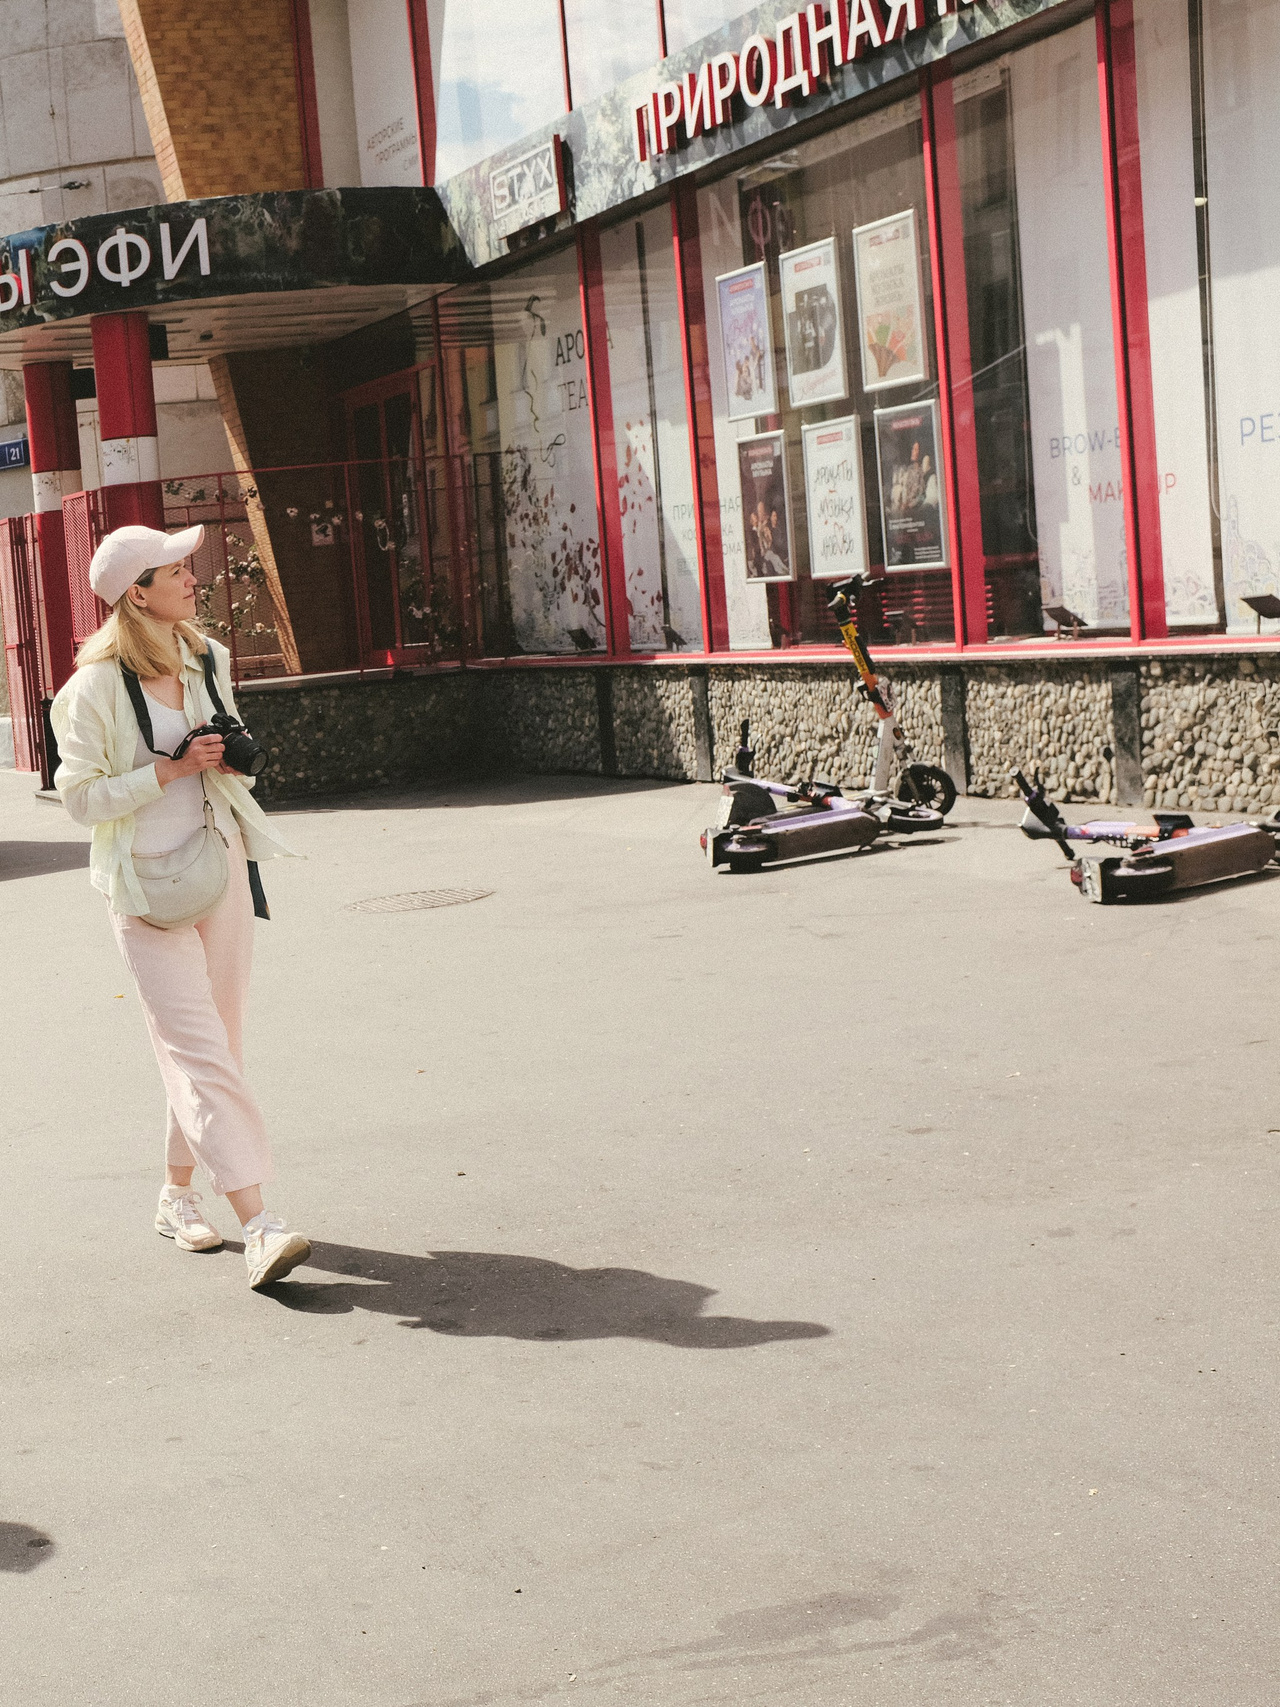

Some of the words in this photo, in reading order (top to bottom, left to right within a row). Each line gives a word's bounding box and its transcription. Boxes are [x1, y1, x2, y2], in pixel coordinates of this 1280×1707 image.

[634, 0, 917, 162] ПРИРОДНАЯ
[493, 151, 553, 210] STYX
[47, 217, 211, 298] ЭФИ
[9, 447, 20, 461] 21
[1240, 412, 1280, 446] РЕ
[844, 628, 867, 672] WHOOSH
